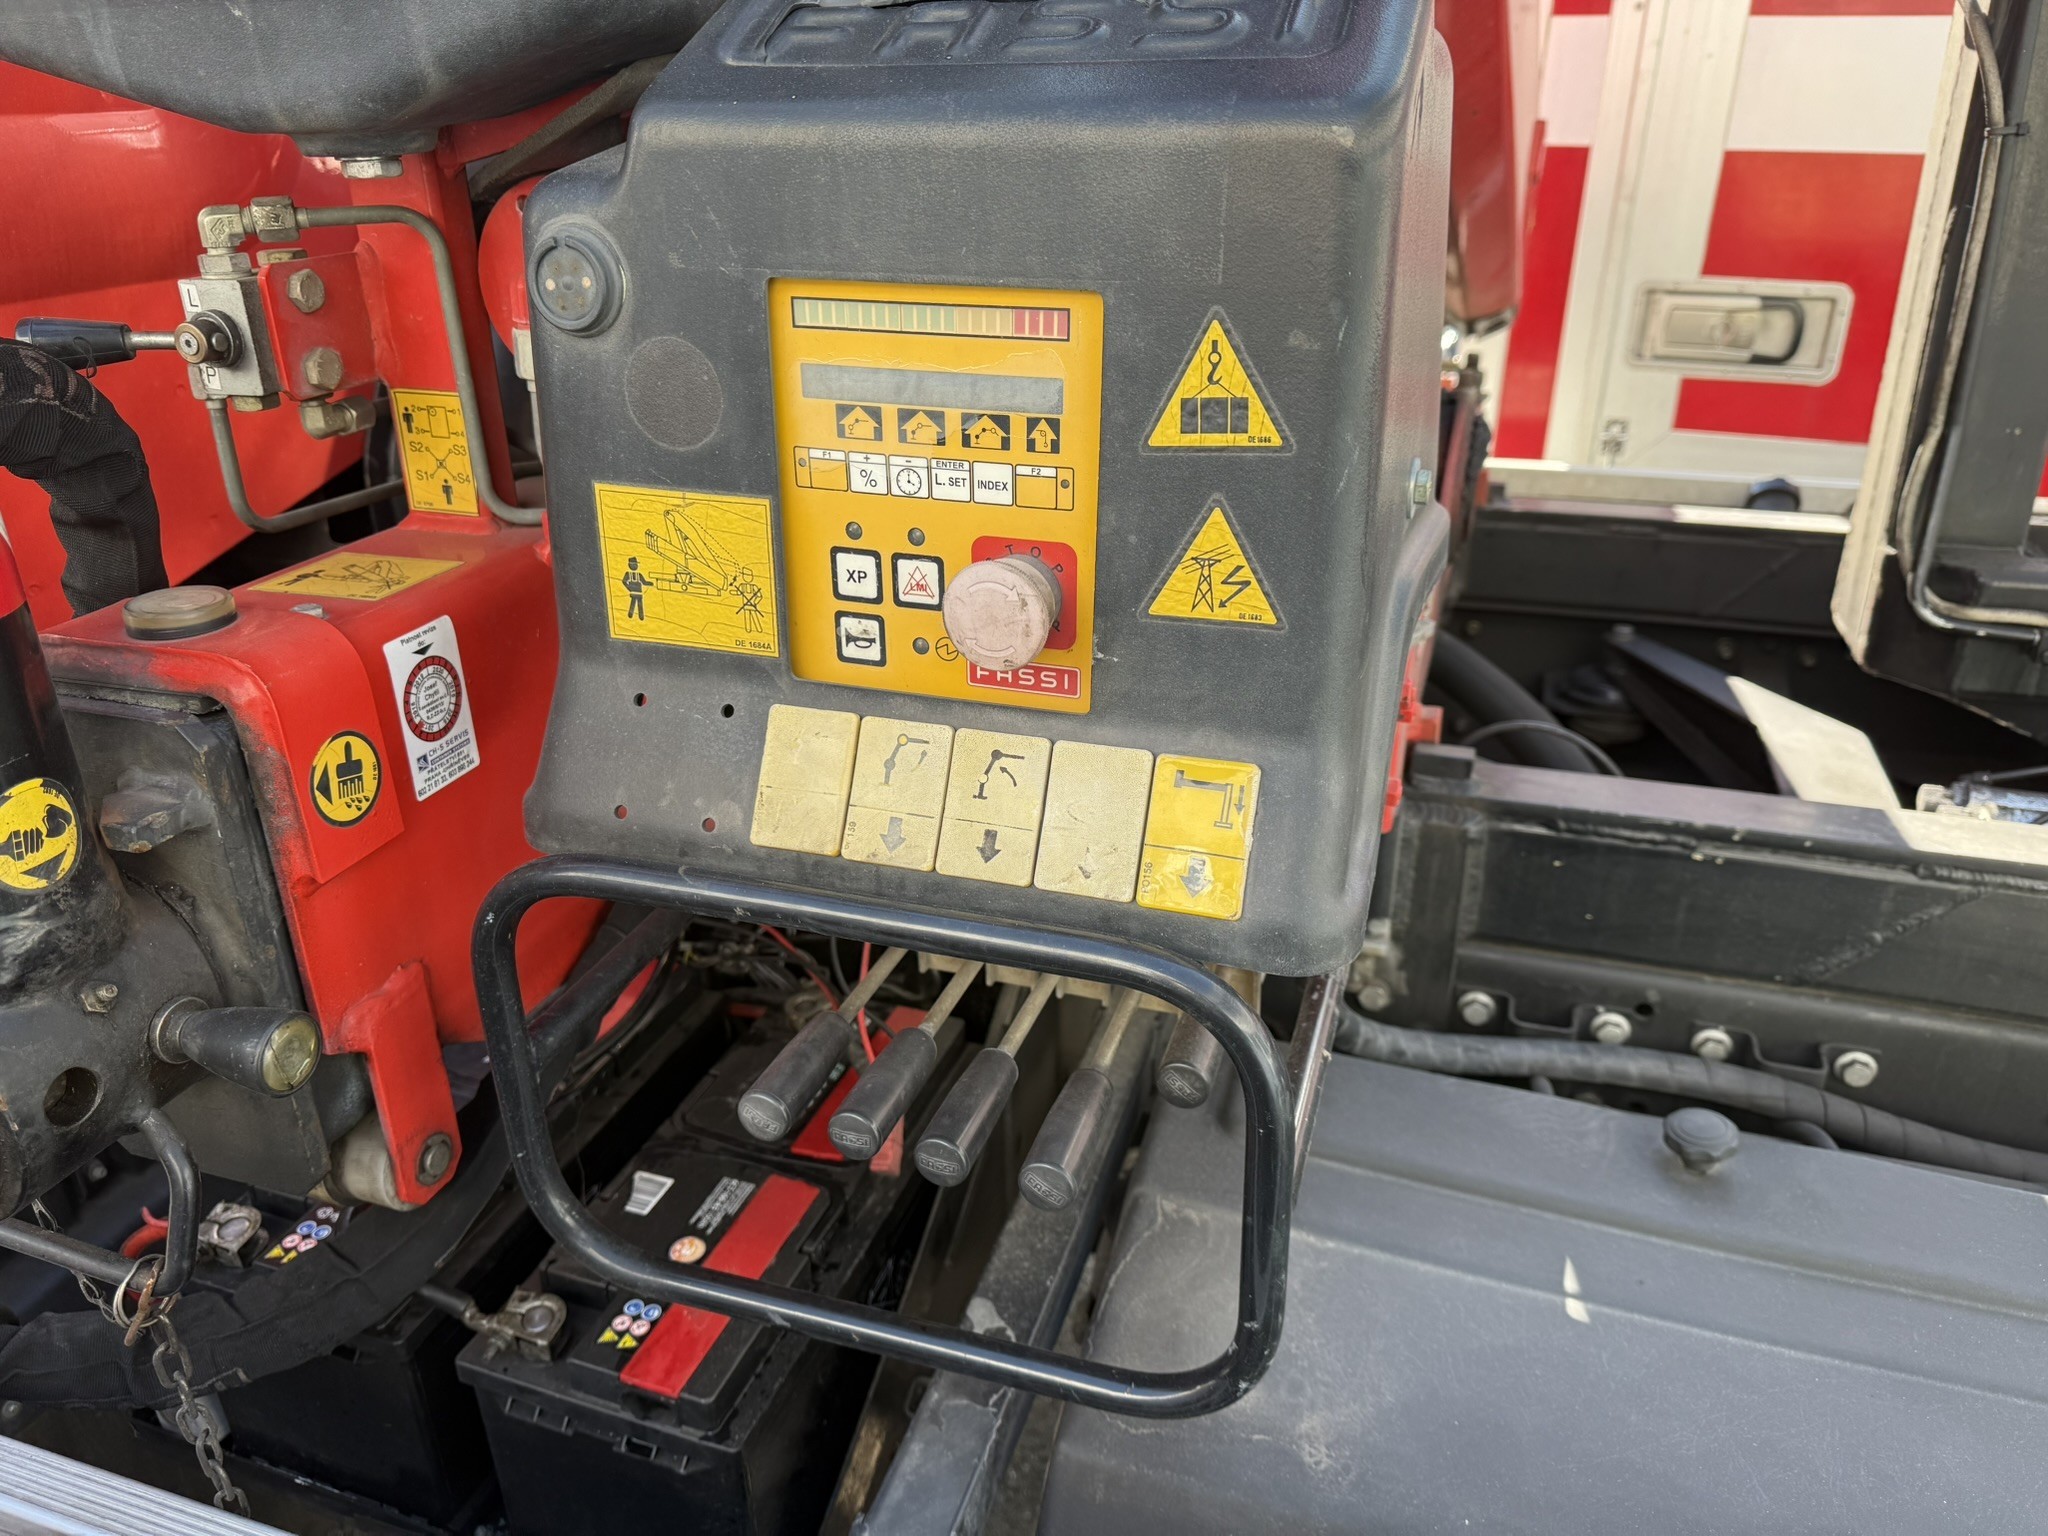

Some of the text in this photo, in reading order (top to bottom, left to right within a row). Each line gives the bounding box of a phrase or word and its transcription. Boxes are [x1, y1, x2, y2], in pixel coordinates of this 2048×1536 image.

[186, 288, 199, 308] L
[204, 366, 217, 384] P
[409, 441, 467, 457] S2 S3
[822, 451, 832, 459] F1
[935, 460, 965, 470] ENTER
[1031, 467, 1042, 476] F2
[416, 469, 471, 485] S1 S4
[859, 469, 878, 488] %
[934, 472, 967, 488] L. SET
[977, 479, 1009, 492] INDEX
[986, 543, 1064, 573] TOP
[846, 568, 868, 584] XP
[909, 581, 927, 592] LMI
[735, 639, 772, 651] DE 1684A
[445, 728, 470, 748] SERVIS
[847, 821, 857, 838] 159
